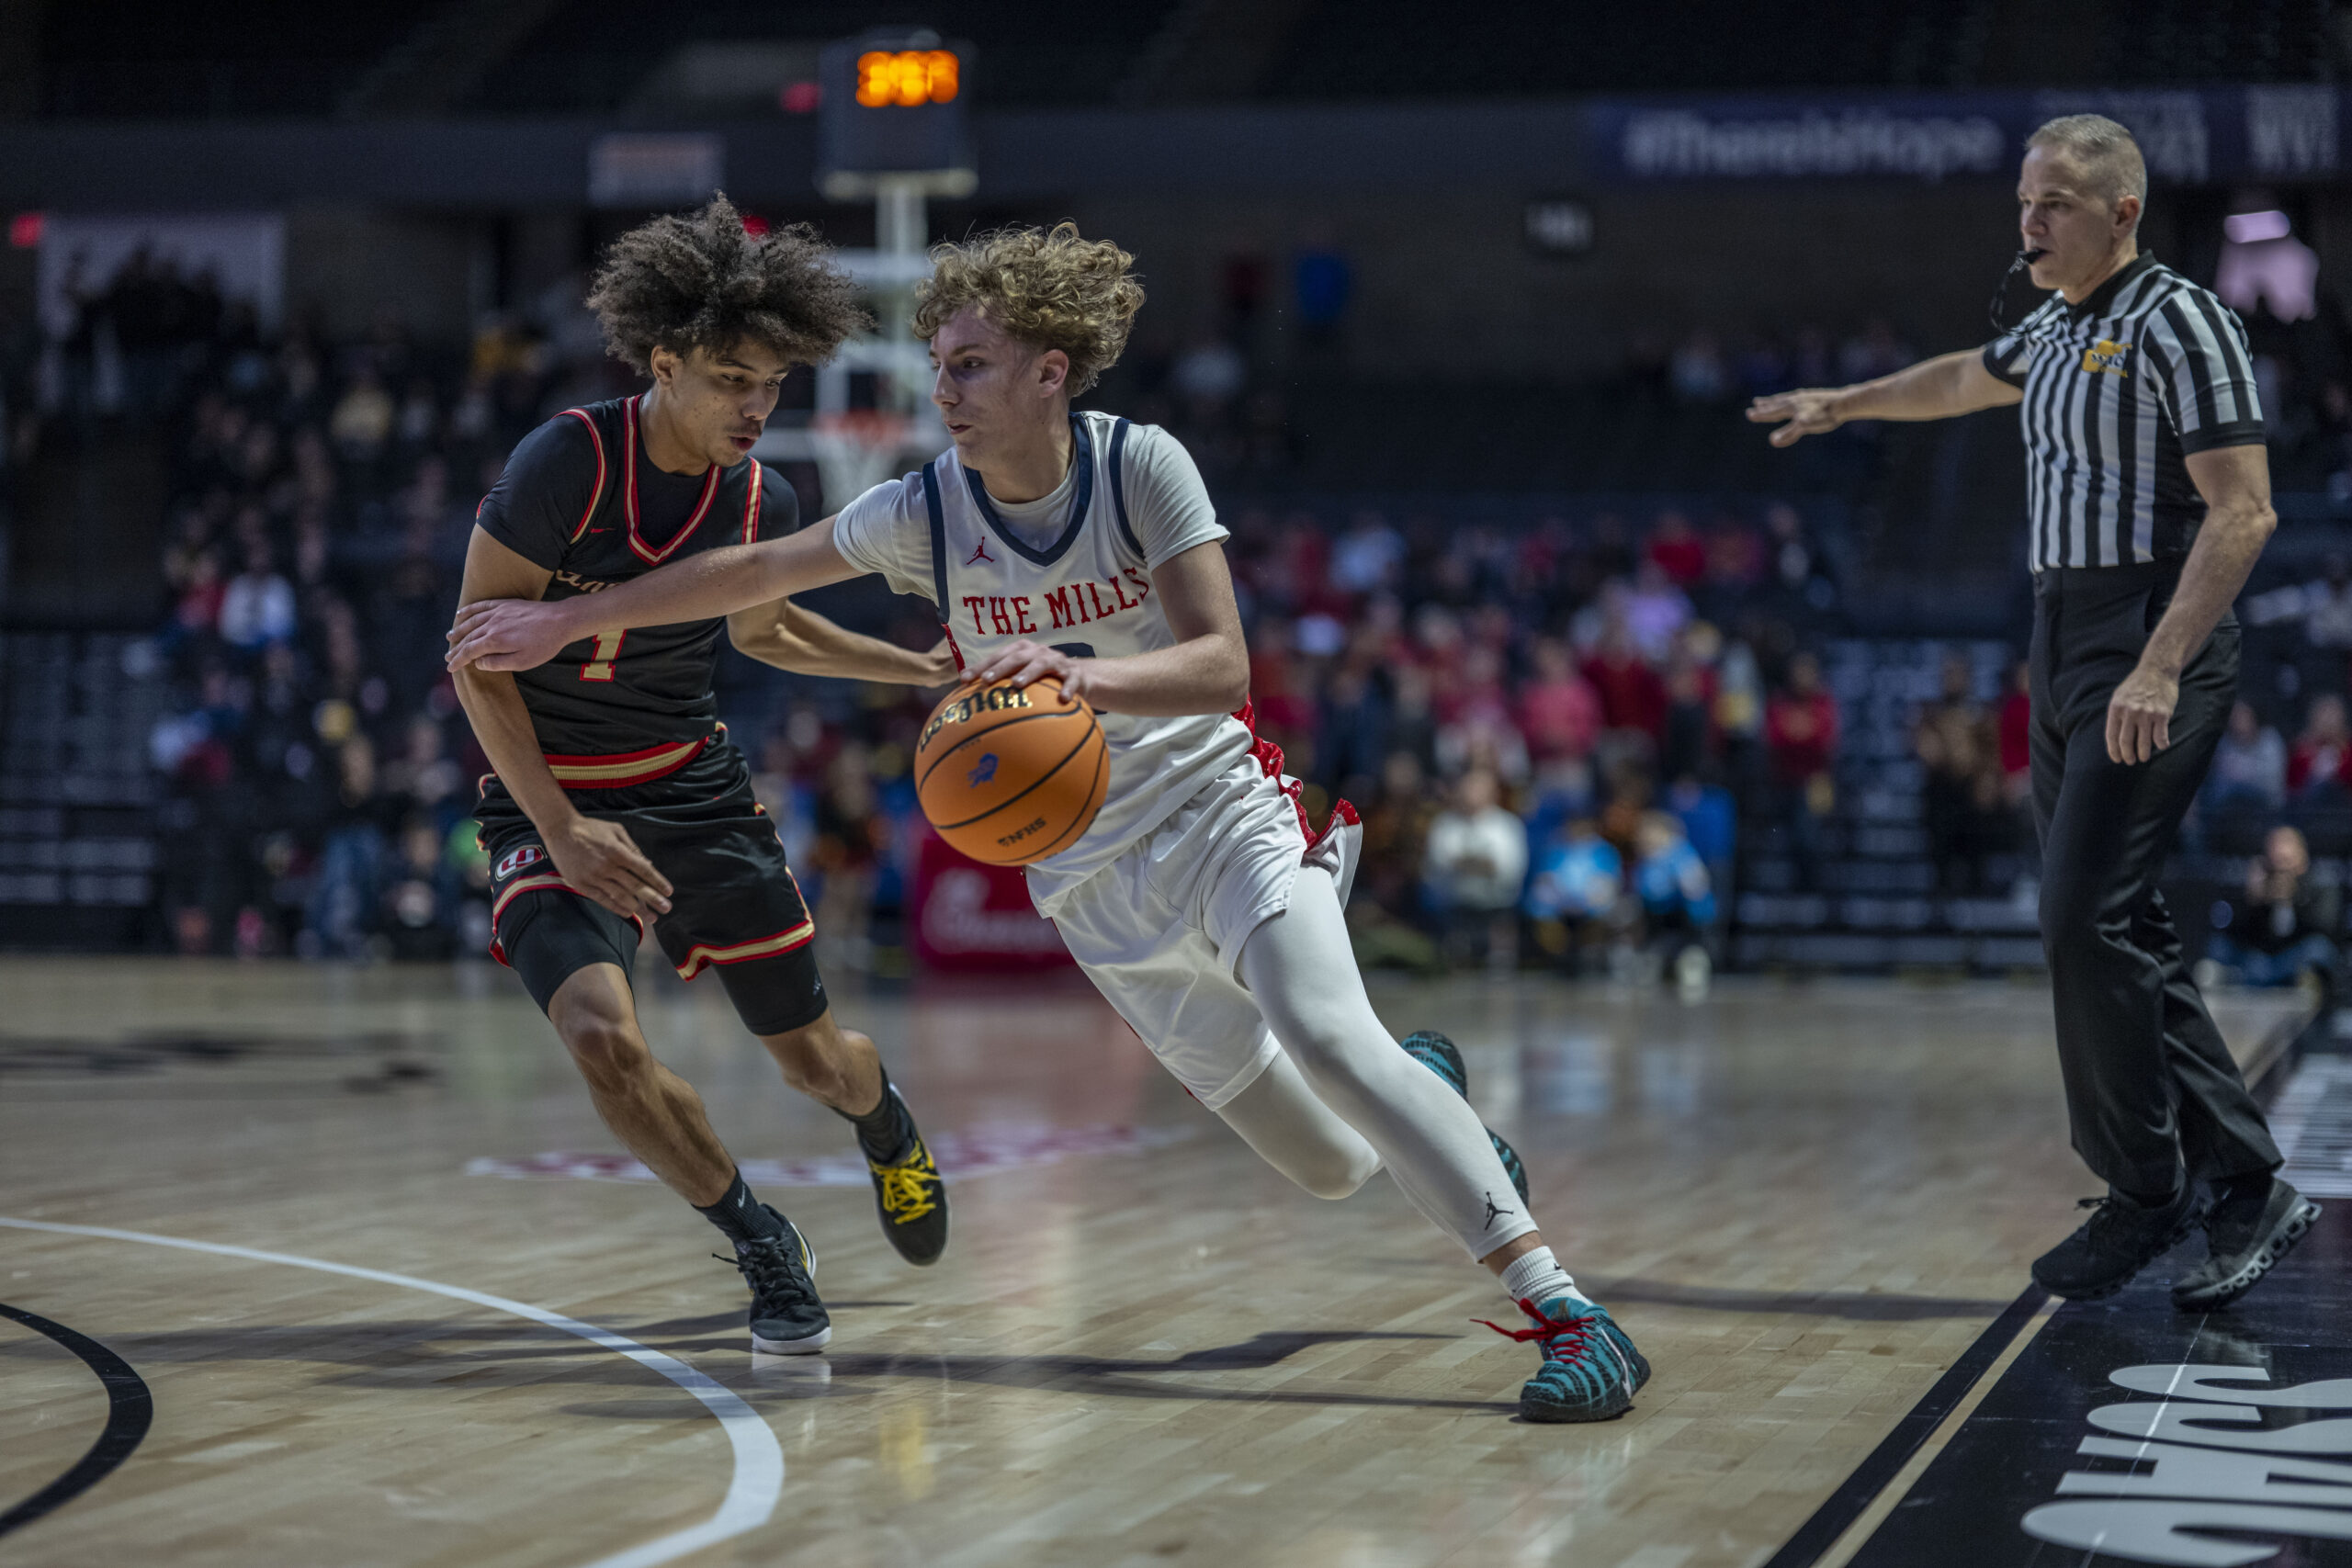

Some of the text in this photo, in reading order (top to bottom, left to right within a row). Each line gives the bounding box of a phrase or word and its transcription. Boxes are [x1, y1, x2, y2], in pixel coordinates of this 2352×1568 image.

[963, 567, 1149, 635] THE MILLS
[580, 628, 628, 682] 1
